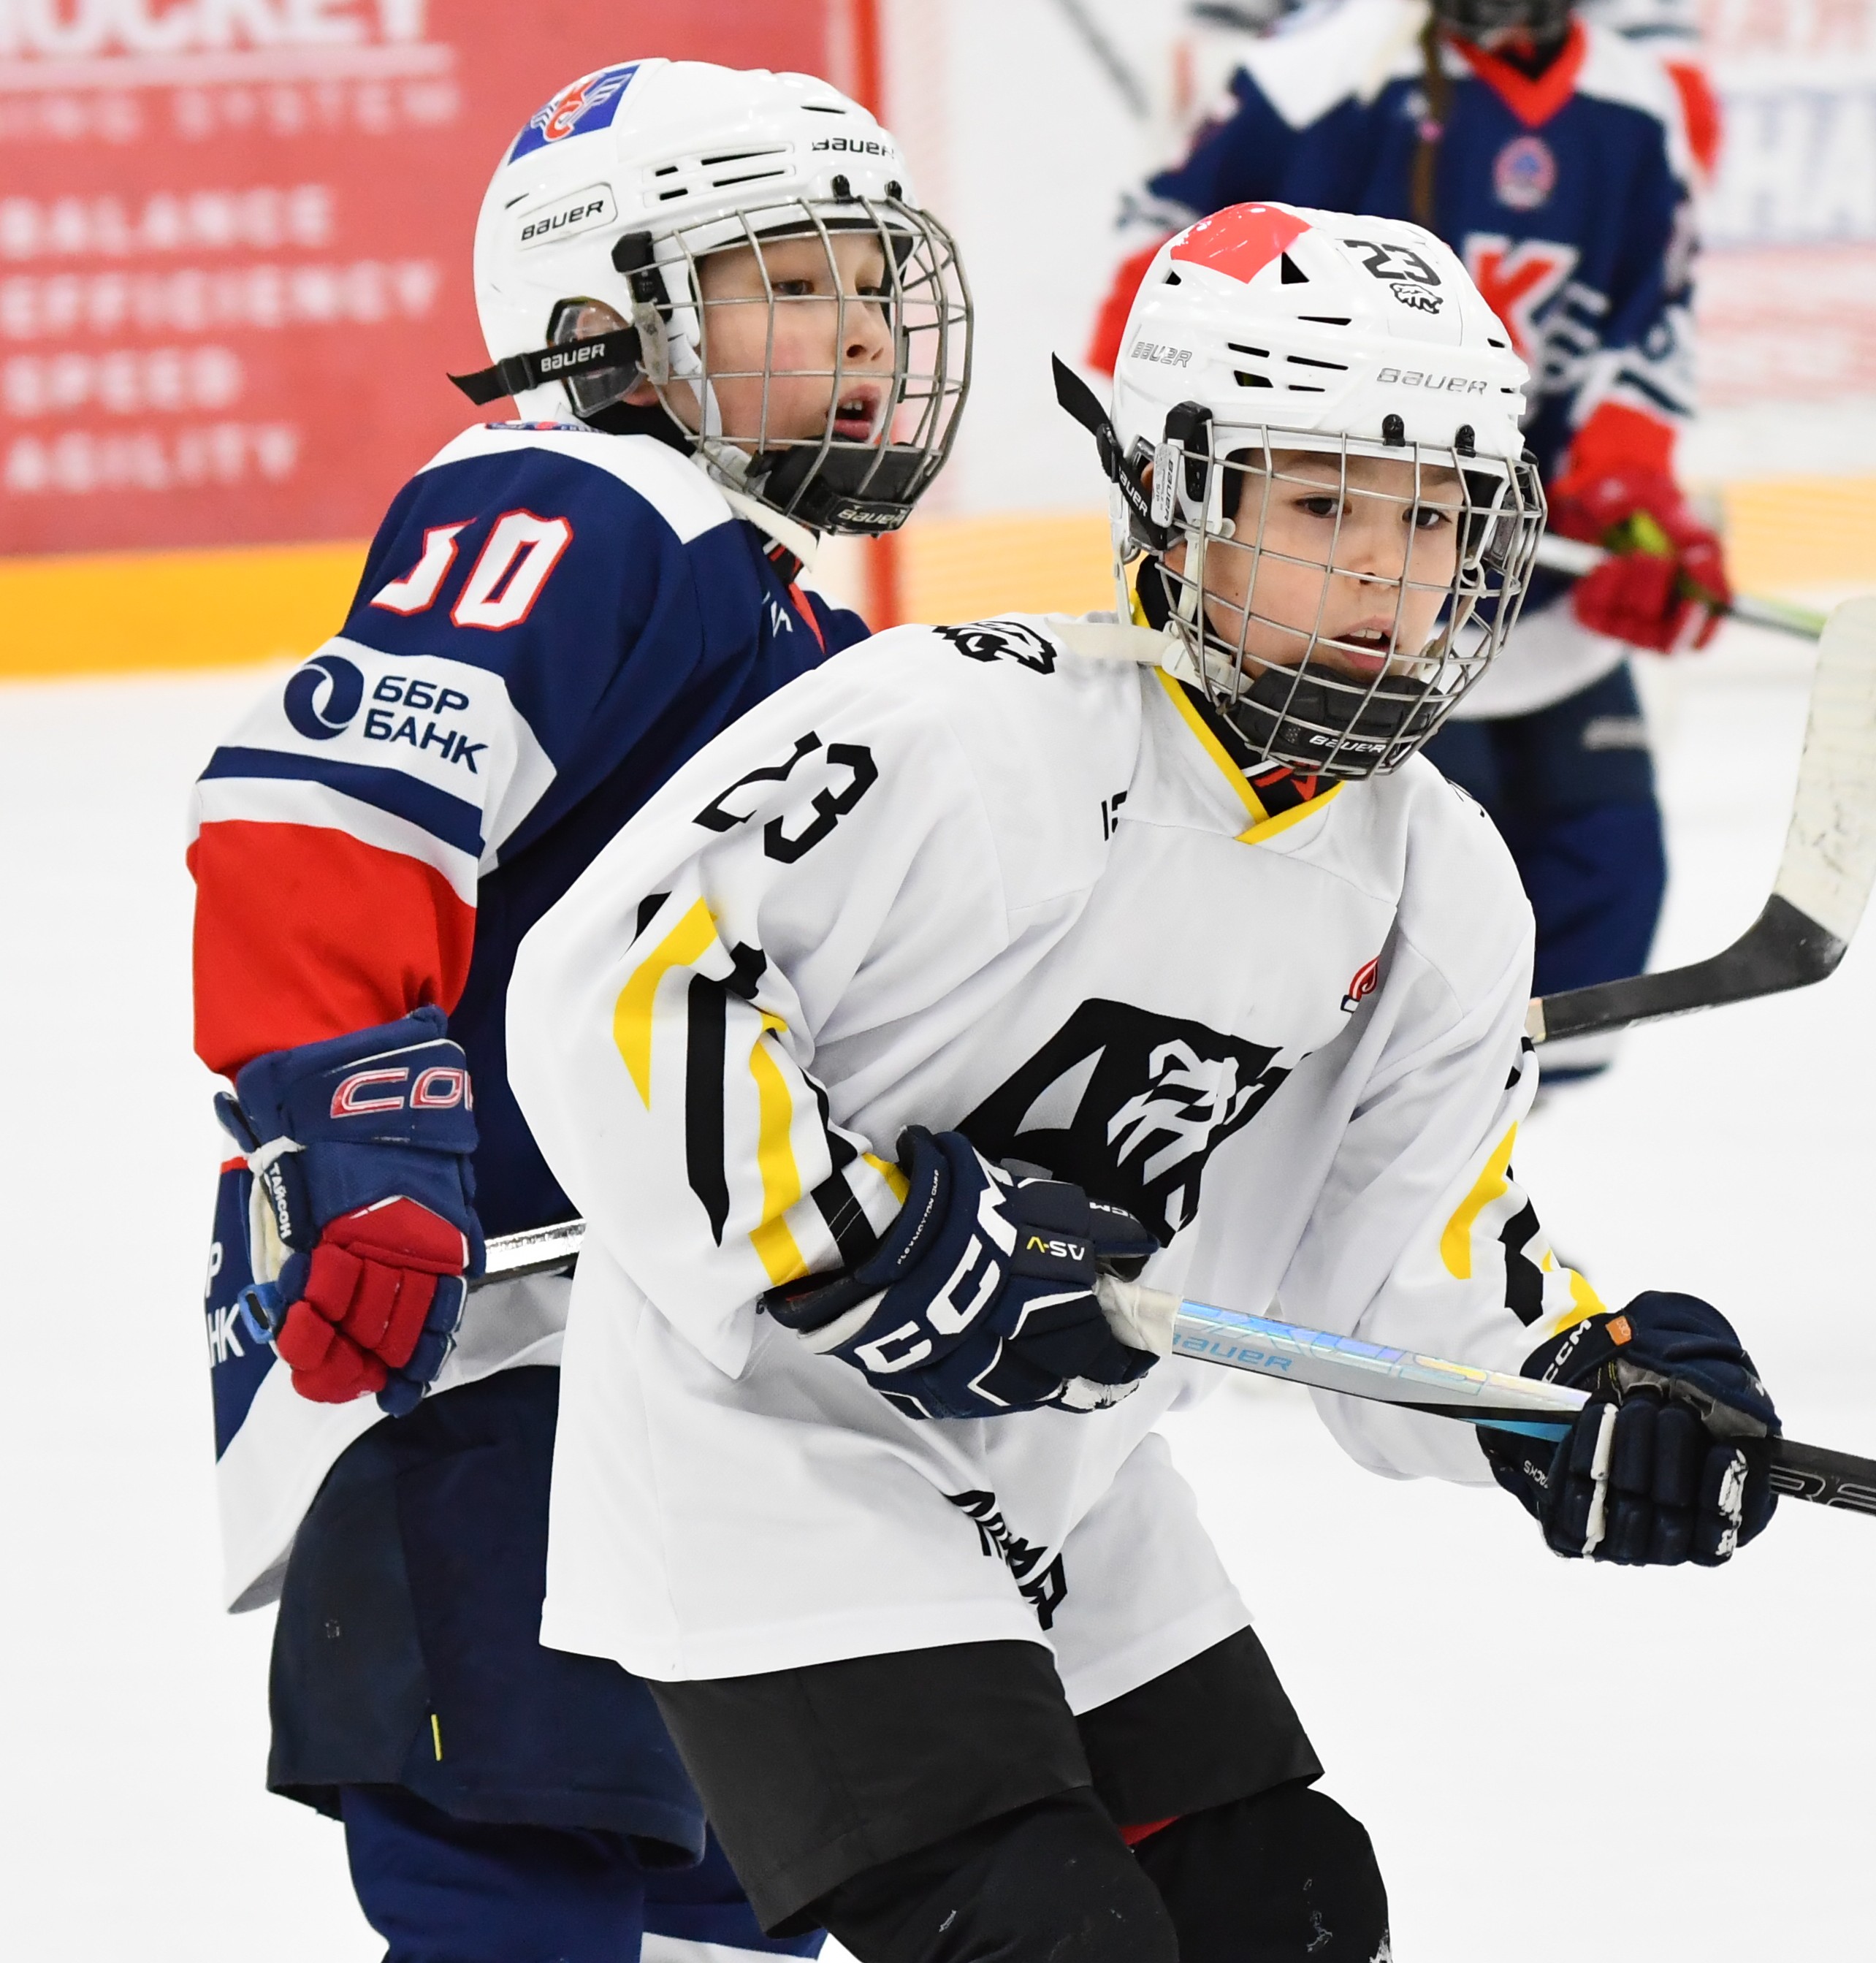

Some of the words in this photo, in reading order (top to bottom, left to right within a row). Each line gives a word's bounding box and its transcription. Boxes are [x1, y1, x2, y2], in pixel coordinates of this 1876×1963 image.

[520, 198, 605, 242] BAUER
[1343, 240, 1441, 287] 23
[540, 342, 606, 373] BAUER
[1131, 341, 1193, 368] BAUER
[1376, 367, 1488, 395] BAUER
[1119, 465, 1148, 517] AUER
[1164, 459, 1174, 522] BAUER
[373, 675, 469, 714] ББР
[363, 708, 489, 774] БАНК
[1309, 734, 1387, 754] BAUER
[692, 731, 878, 864] 23
[330, 1067, 474, 1118] CO
[855, 1146, 1019, 1373] CCM
[1026, 1235, 1086, 1261] AS-V
[1541, 1319, 1592, 1384] CCM
